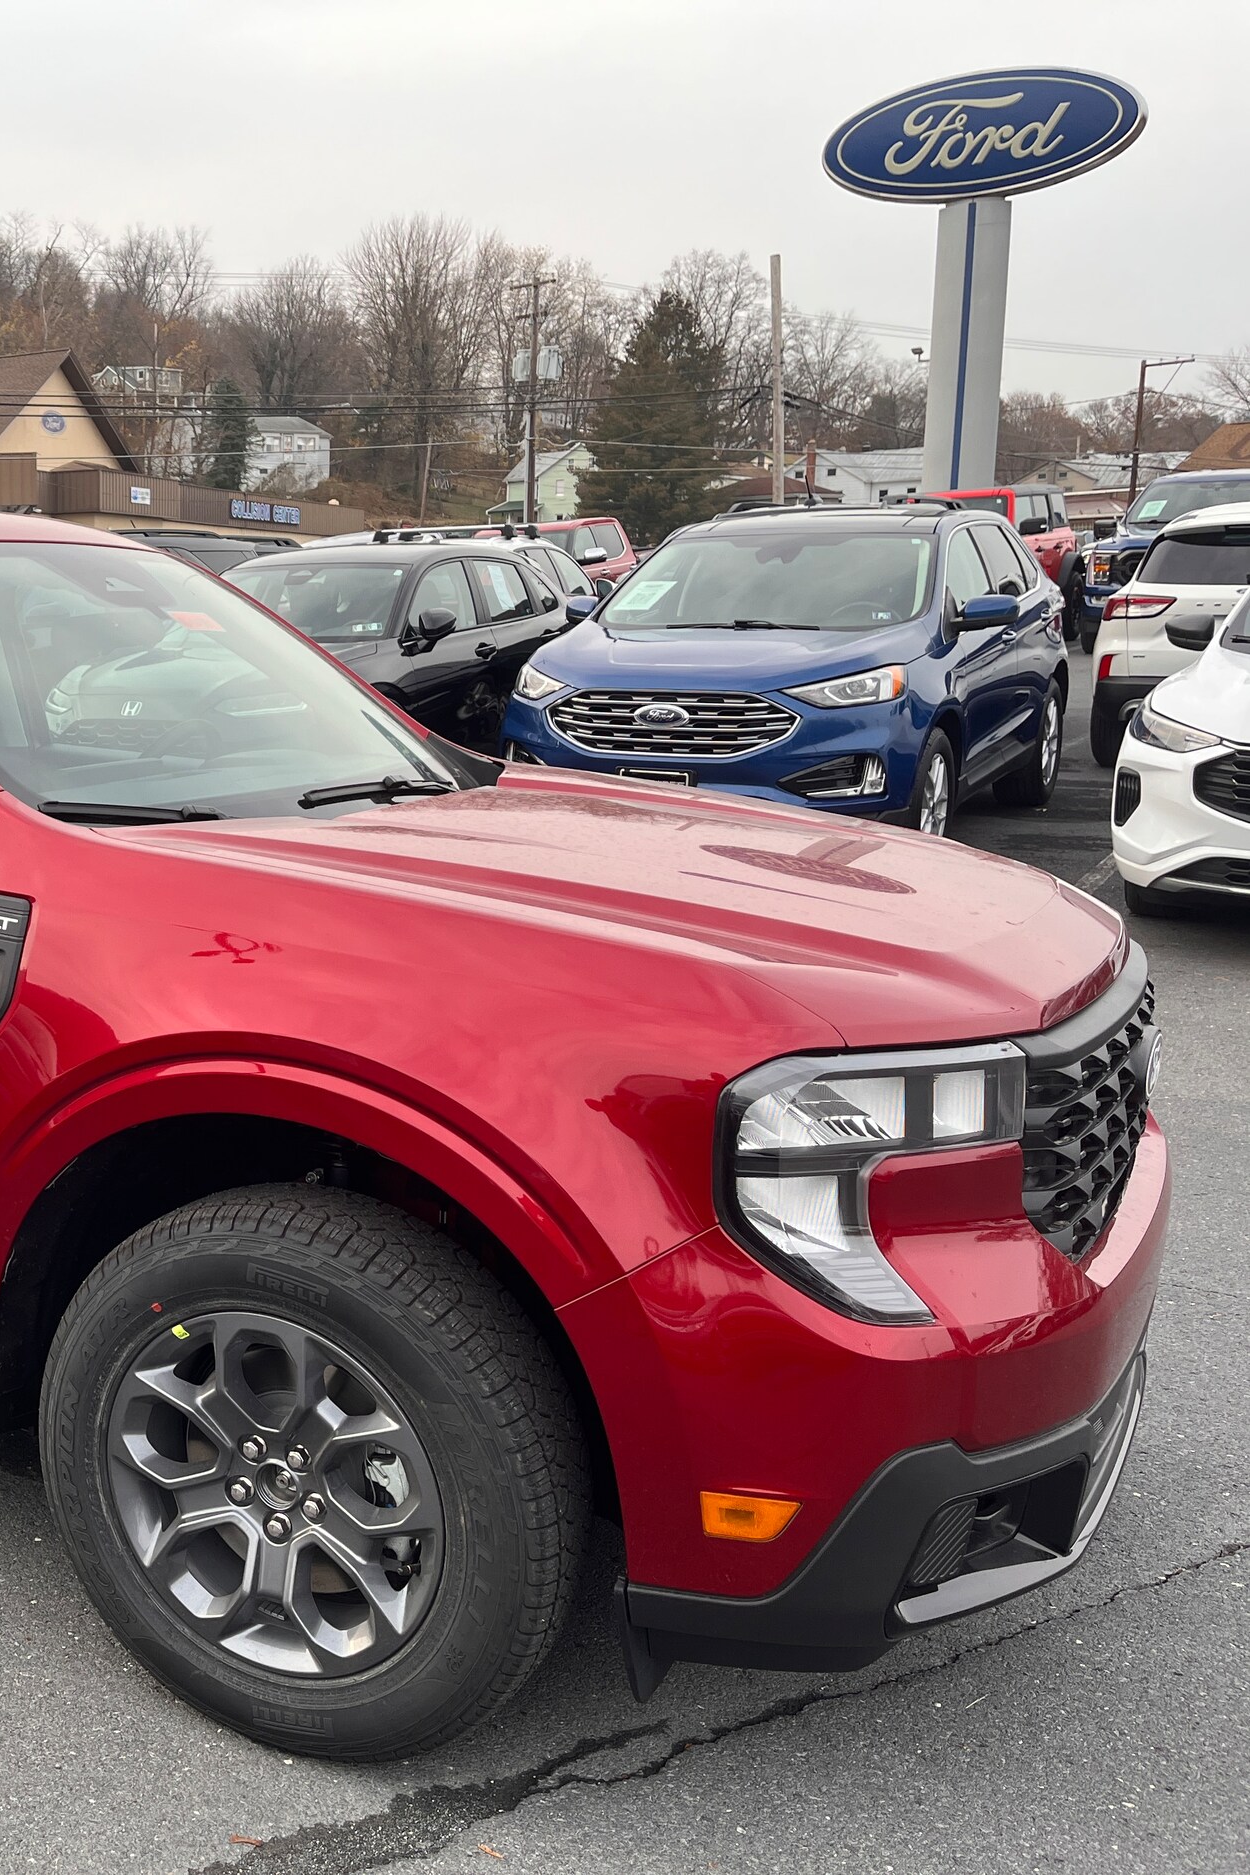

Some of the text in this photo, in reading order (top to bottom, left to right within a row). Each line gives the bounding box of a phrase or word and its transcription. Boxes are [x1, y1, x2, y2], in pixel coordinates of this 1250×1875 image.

[884, 92, 1071, 175] Ford
[231, 499, 300, 524] COLLISION CENTER
[647, 708, 675, 721] Ford
[246, 1262, 330, 1308] PIRELLI
[80, 1297, 128, 1367] ATR
[57, 1380, 138, 1624] SCORPION
[437, 1419, 495, 1627] PIRELLI
[252, 1705, 335, 1738] PIRELLI
